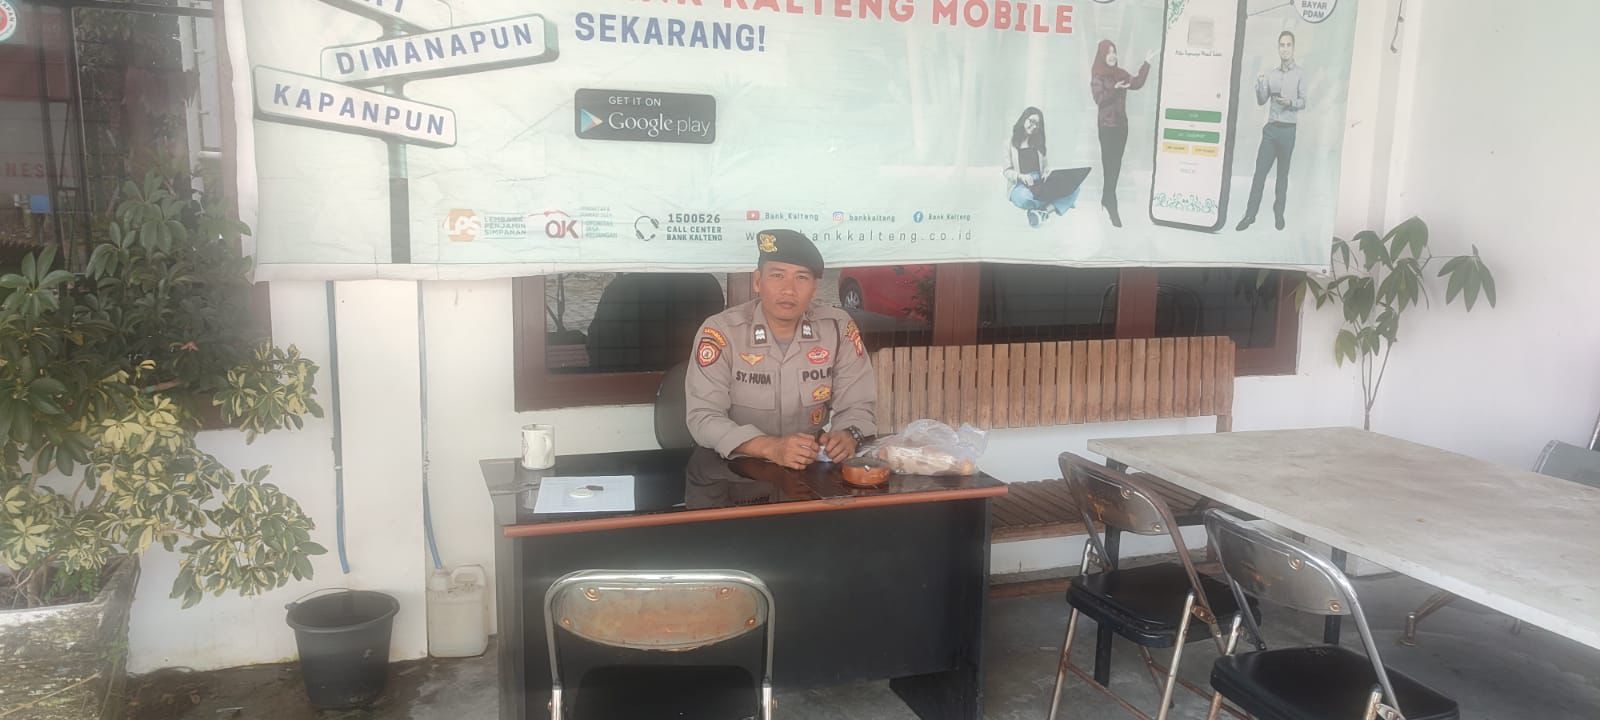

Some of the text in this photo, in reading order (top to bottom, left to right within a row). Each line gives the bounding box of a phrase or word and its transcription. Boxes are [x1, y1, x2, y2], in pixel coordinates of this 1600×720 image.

[1301, 0, 1328, 10] BAYAR
[932, 0, 1073, 34] MOBILE
[1303, 10, 1325, 18] PDAM
[575, 12, 766, 52] SEKARANG!
[335, 23, 533, 75] DIMANAPUN
[608, 96, 662, 106] GET IT ON
[273, 83, 444, 136] KAPANPUN
[608, 112, 711, 138] Google play
[668, 213, 721, 223] 1500526
[849, 214, 896, 223] bankkalteng
[946, 213, 971, 221] Kalteng
[746, 230, 972, 243] wankkalteng.co.id
[748, 372, 772, 385] HUDA
